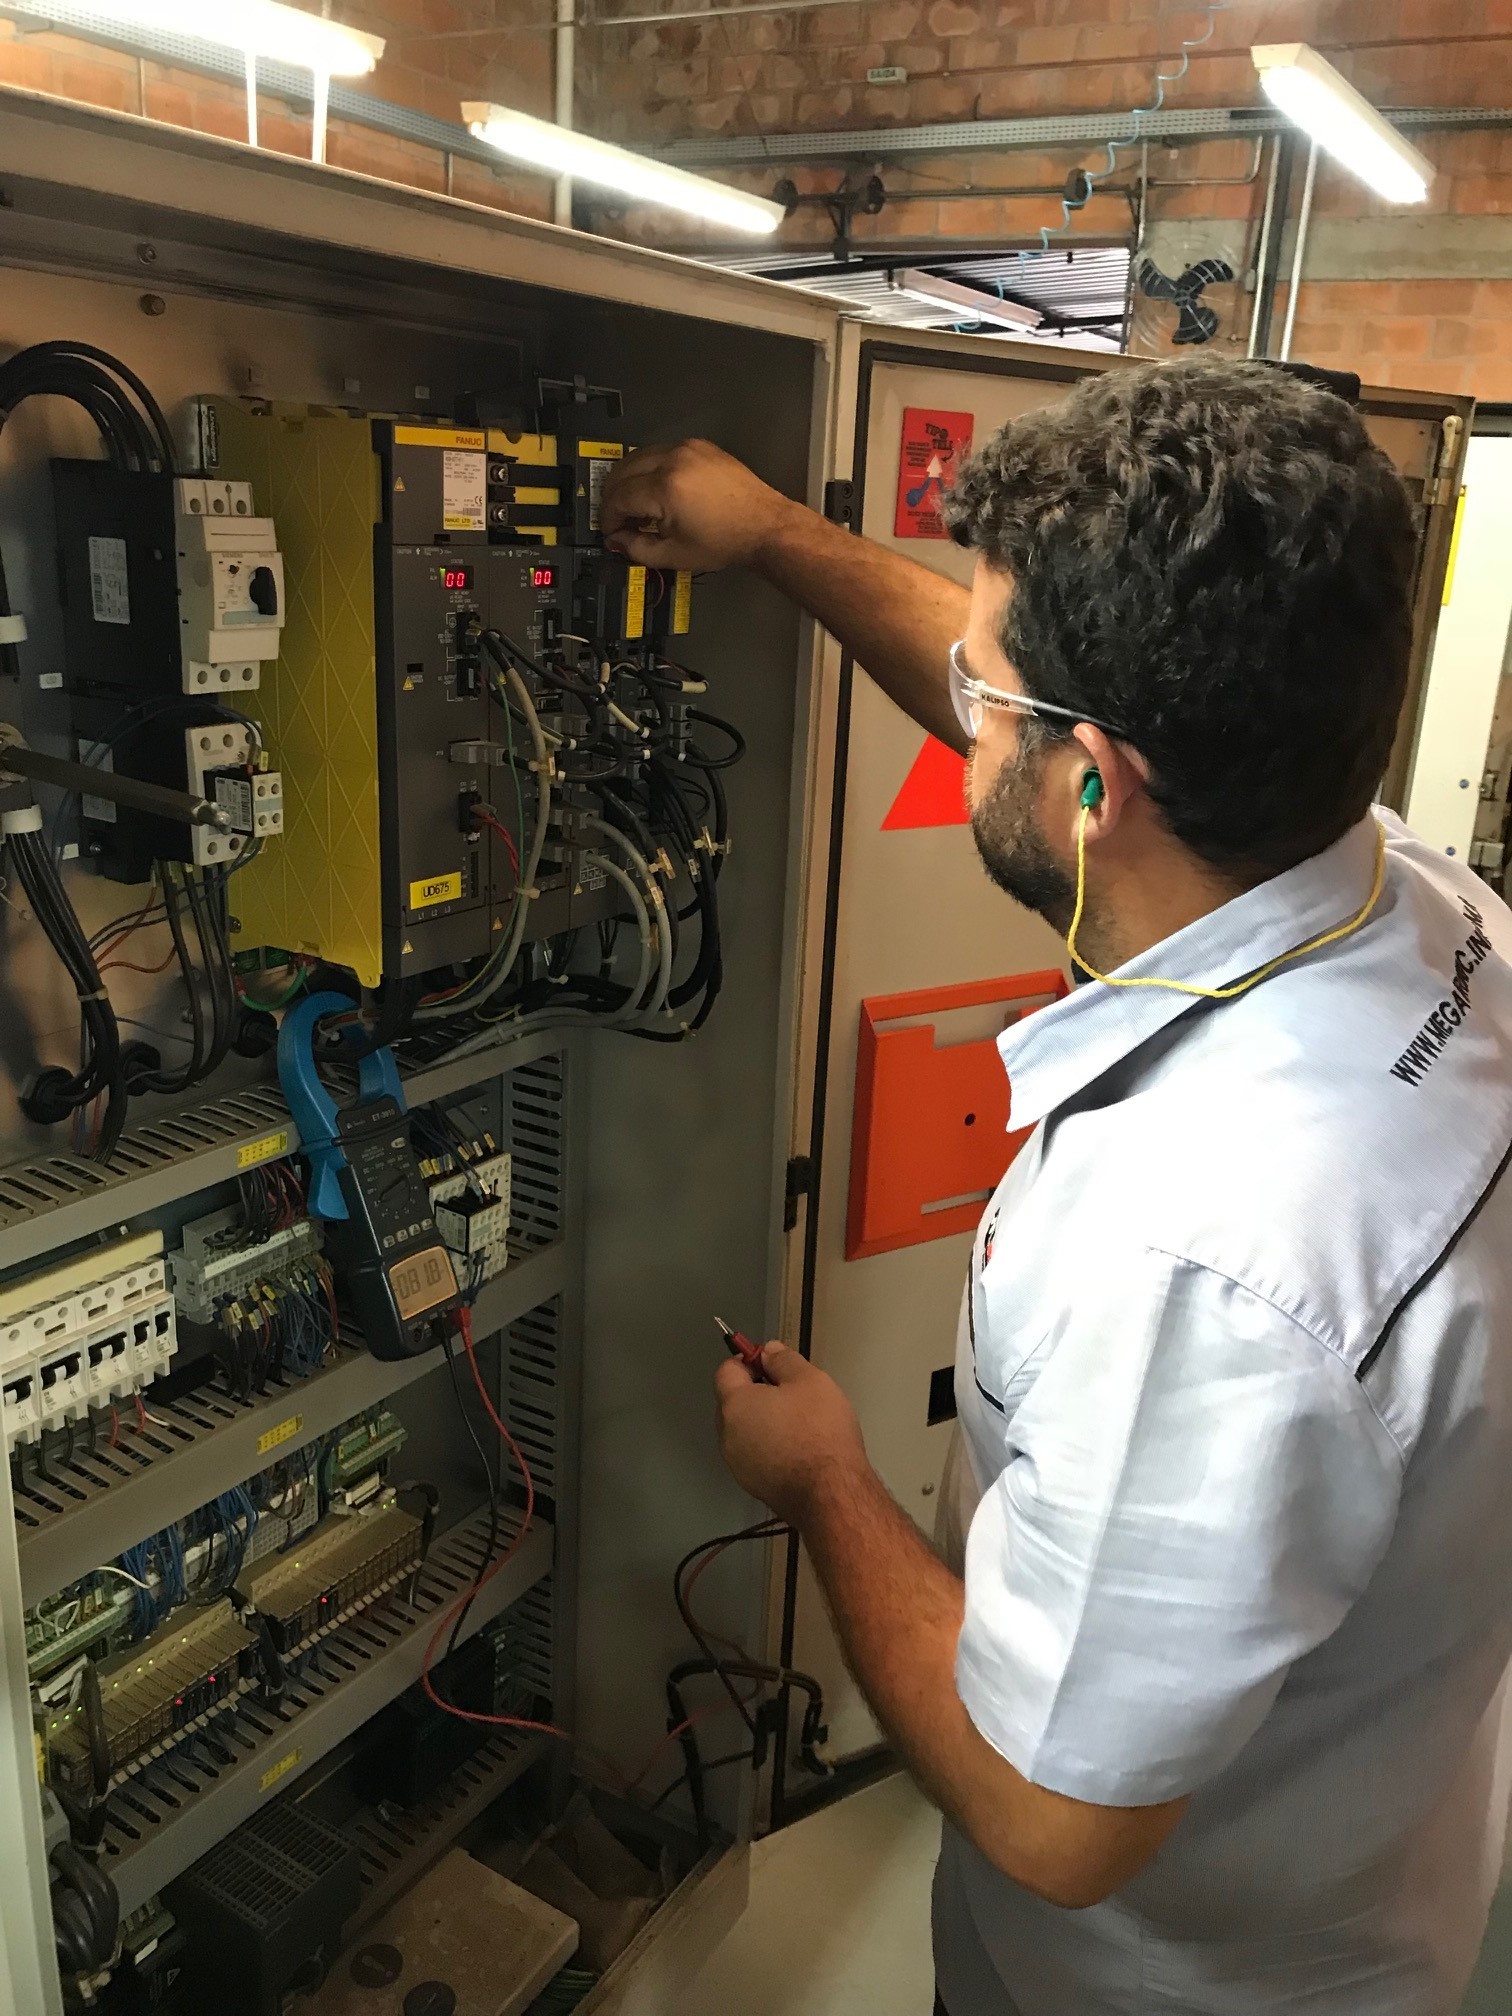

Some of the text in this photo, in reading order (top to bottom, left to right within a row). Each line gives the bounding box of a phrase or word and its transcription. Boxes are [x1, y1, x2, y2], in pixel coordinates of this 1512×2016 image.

[456, 436, 482, 447] FANUC
[600, 447, 622, 456] FANUC
[445, 572, 465, 587] 00
[534, 571, 552, 585] 00
[981, 694, 1010, 707] KALIPSO
[423, 881, 450, 898] UD675
